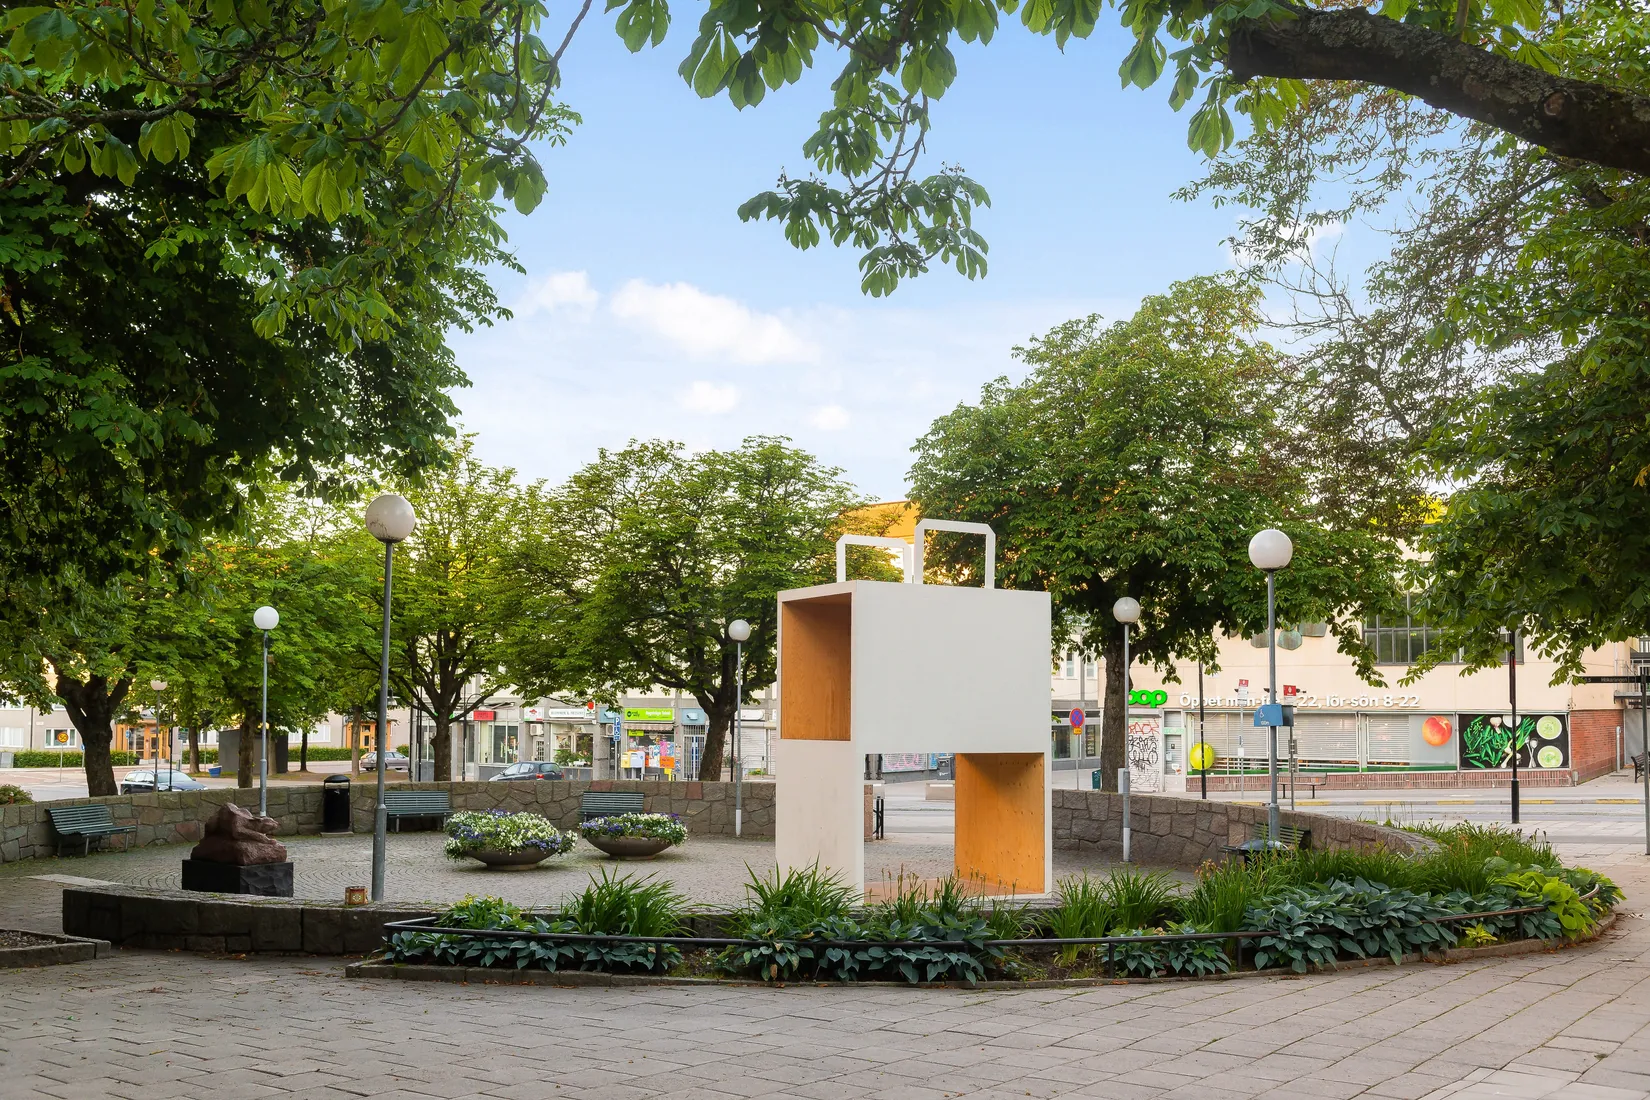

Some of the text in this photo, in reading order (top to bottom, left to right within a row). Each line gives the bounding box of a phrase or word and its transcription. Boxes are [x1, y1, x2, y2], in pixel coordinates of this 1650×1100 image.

[1128, 690, 1168, 708] oop
[1326, 694, 1379, 707] lör-sön
[1383, 695, 1420, 707] 8-22
